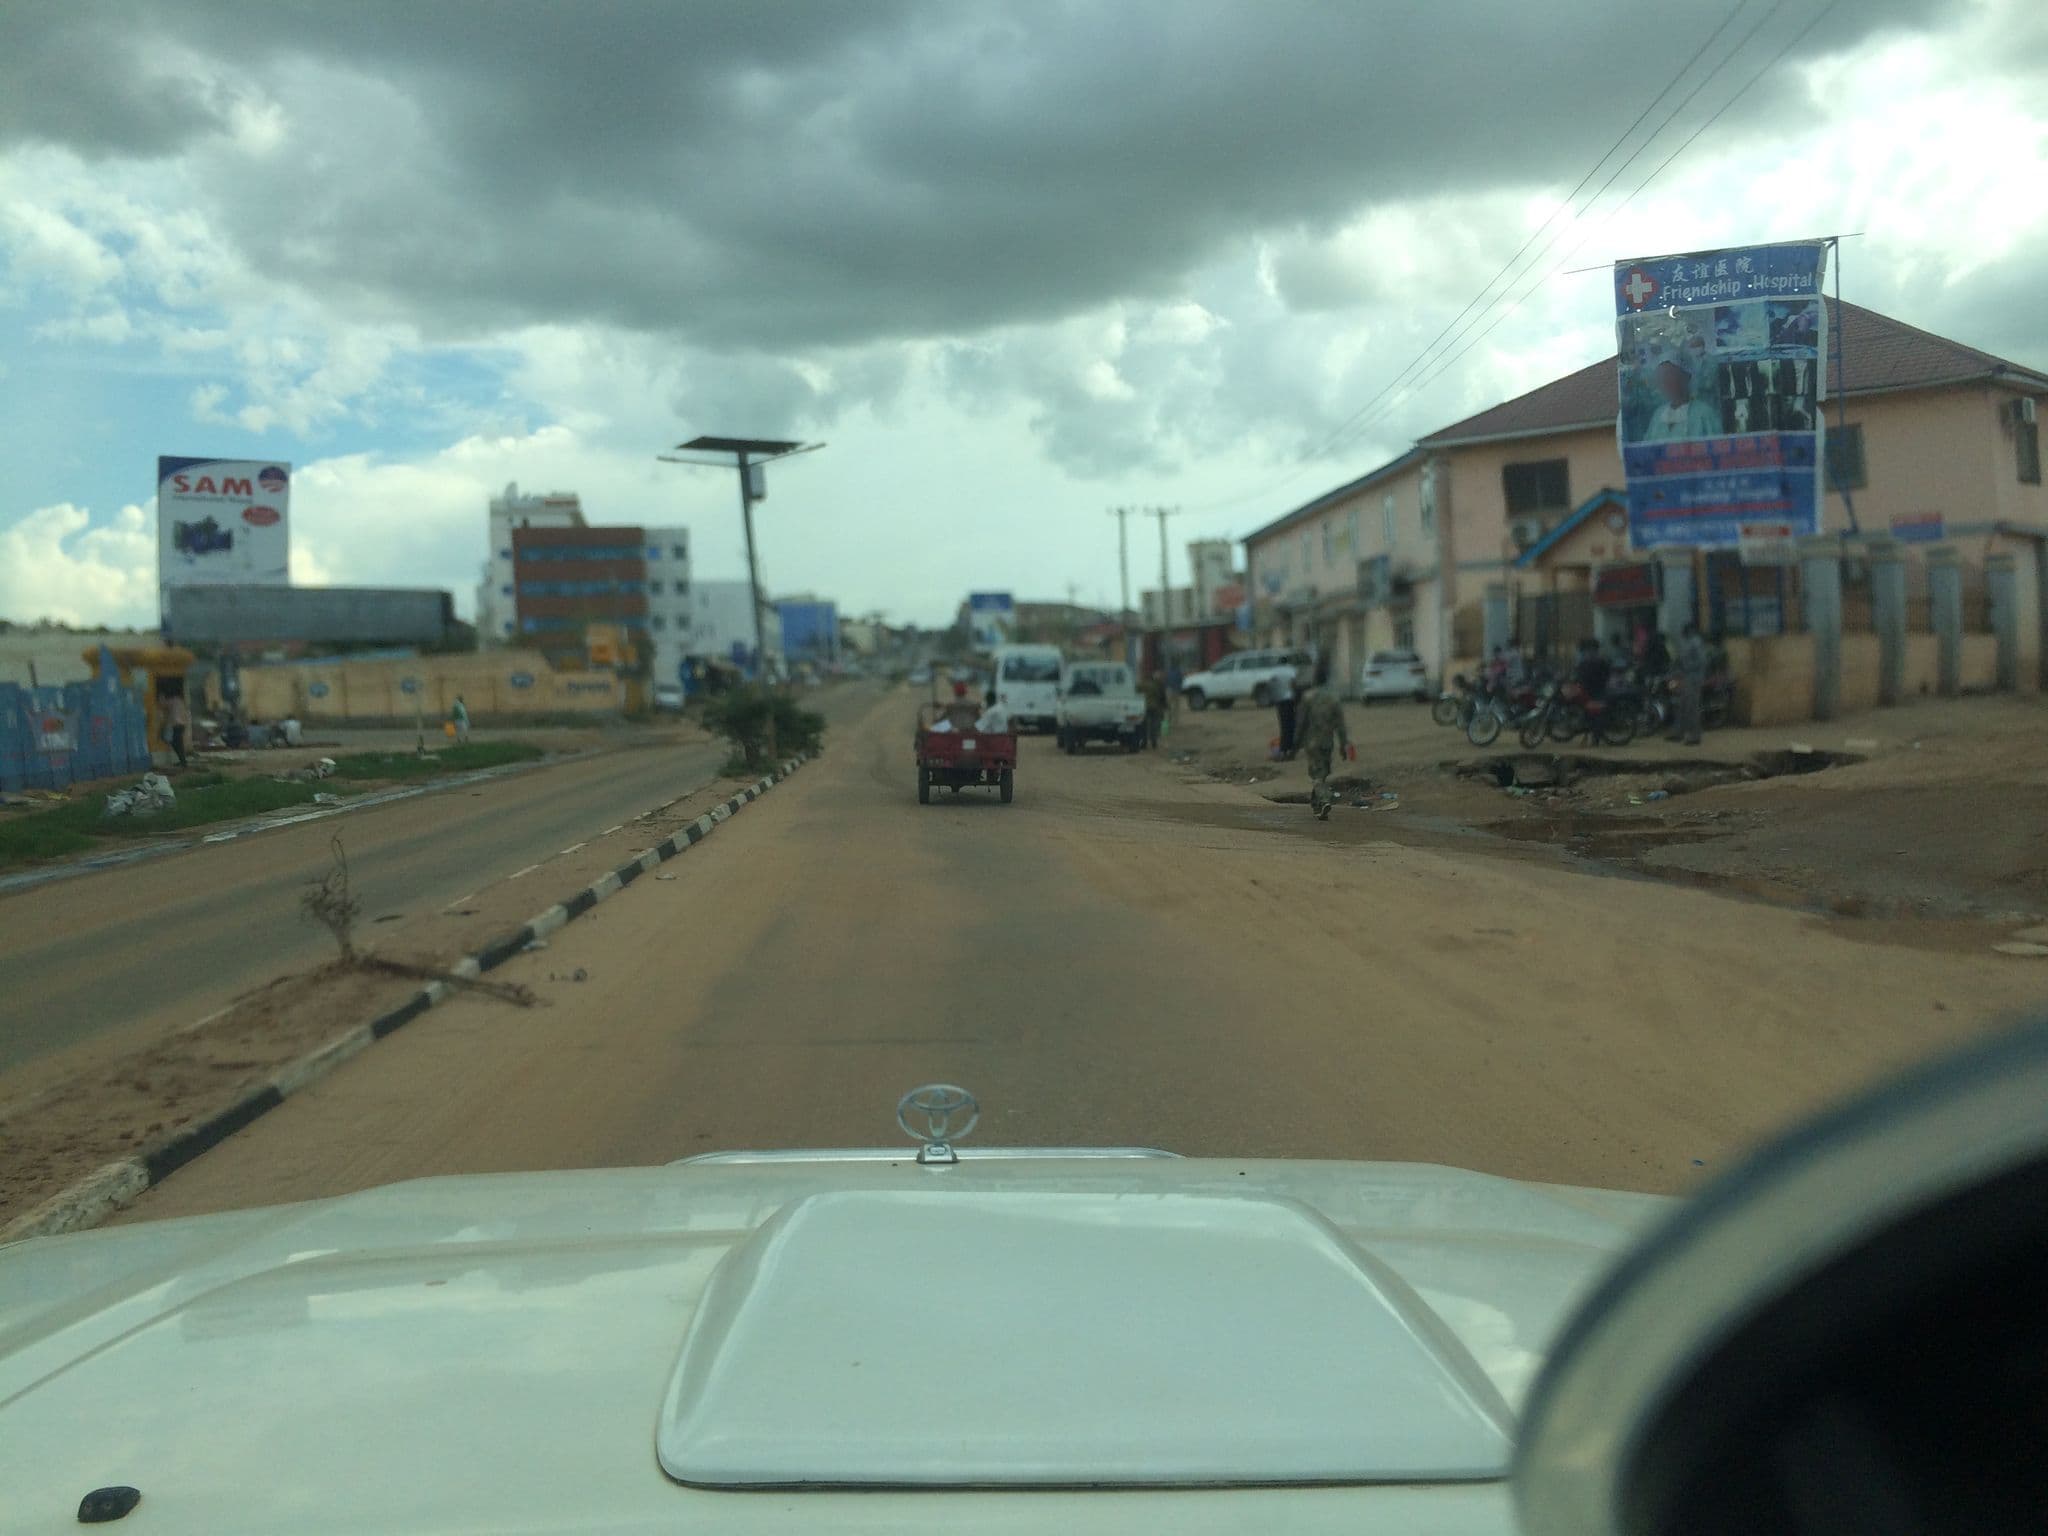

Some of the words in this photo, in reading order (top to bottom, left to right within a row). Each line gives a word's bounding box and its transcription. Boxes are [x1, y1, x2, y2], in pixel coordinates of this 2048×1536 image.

[1672, 256, 1754, 282] 友谊医院
[1663, 279, 1741, 301] Friendship
[1753, 271, 1812, 292] Hospital
[173, 474, 253, 497] SAM
